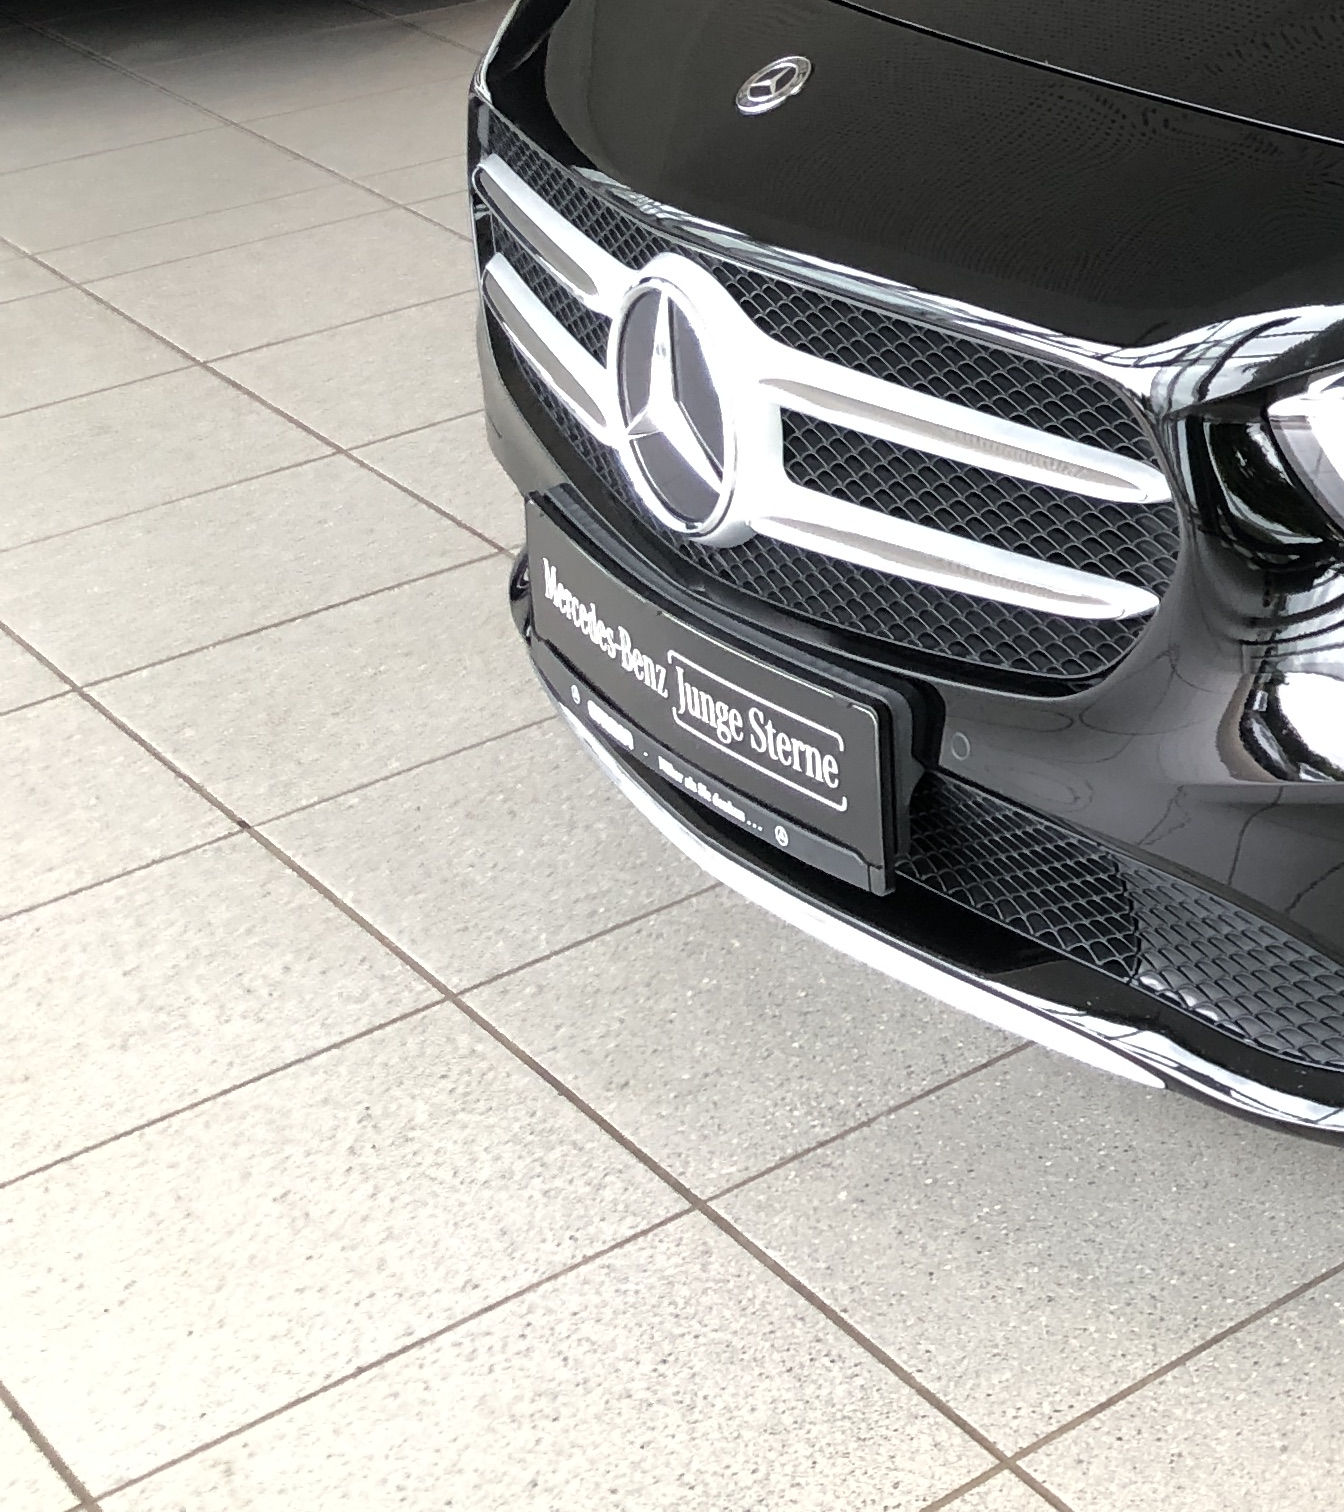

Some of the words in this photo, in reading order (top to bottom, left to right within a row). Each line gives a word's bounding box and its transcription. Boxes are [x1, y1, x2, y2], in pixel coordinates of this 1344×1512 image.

[543, 557, 668, 698] Mercedes-Benz
[676, 665, 744, 744] Junge
[748, 707, 839, 788] Sterne
